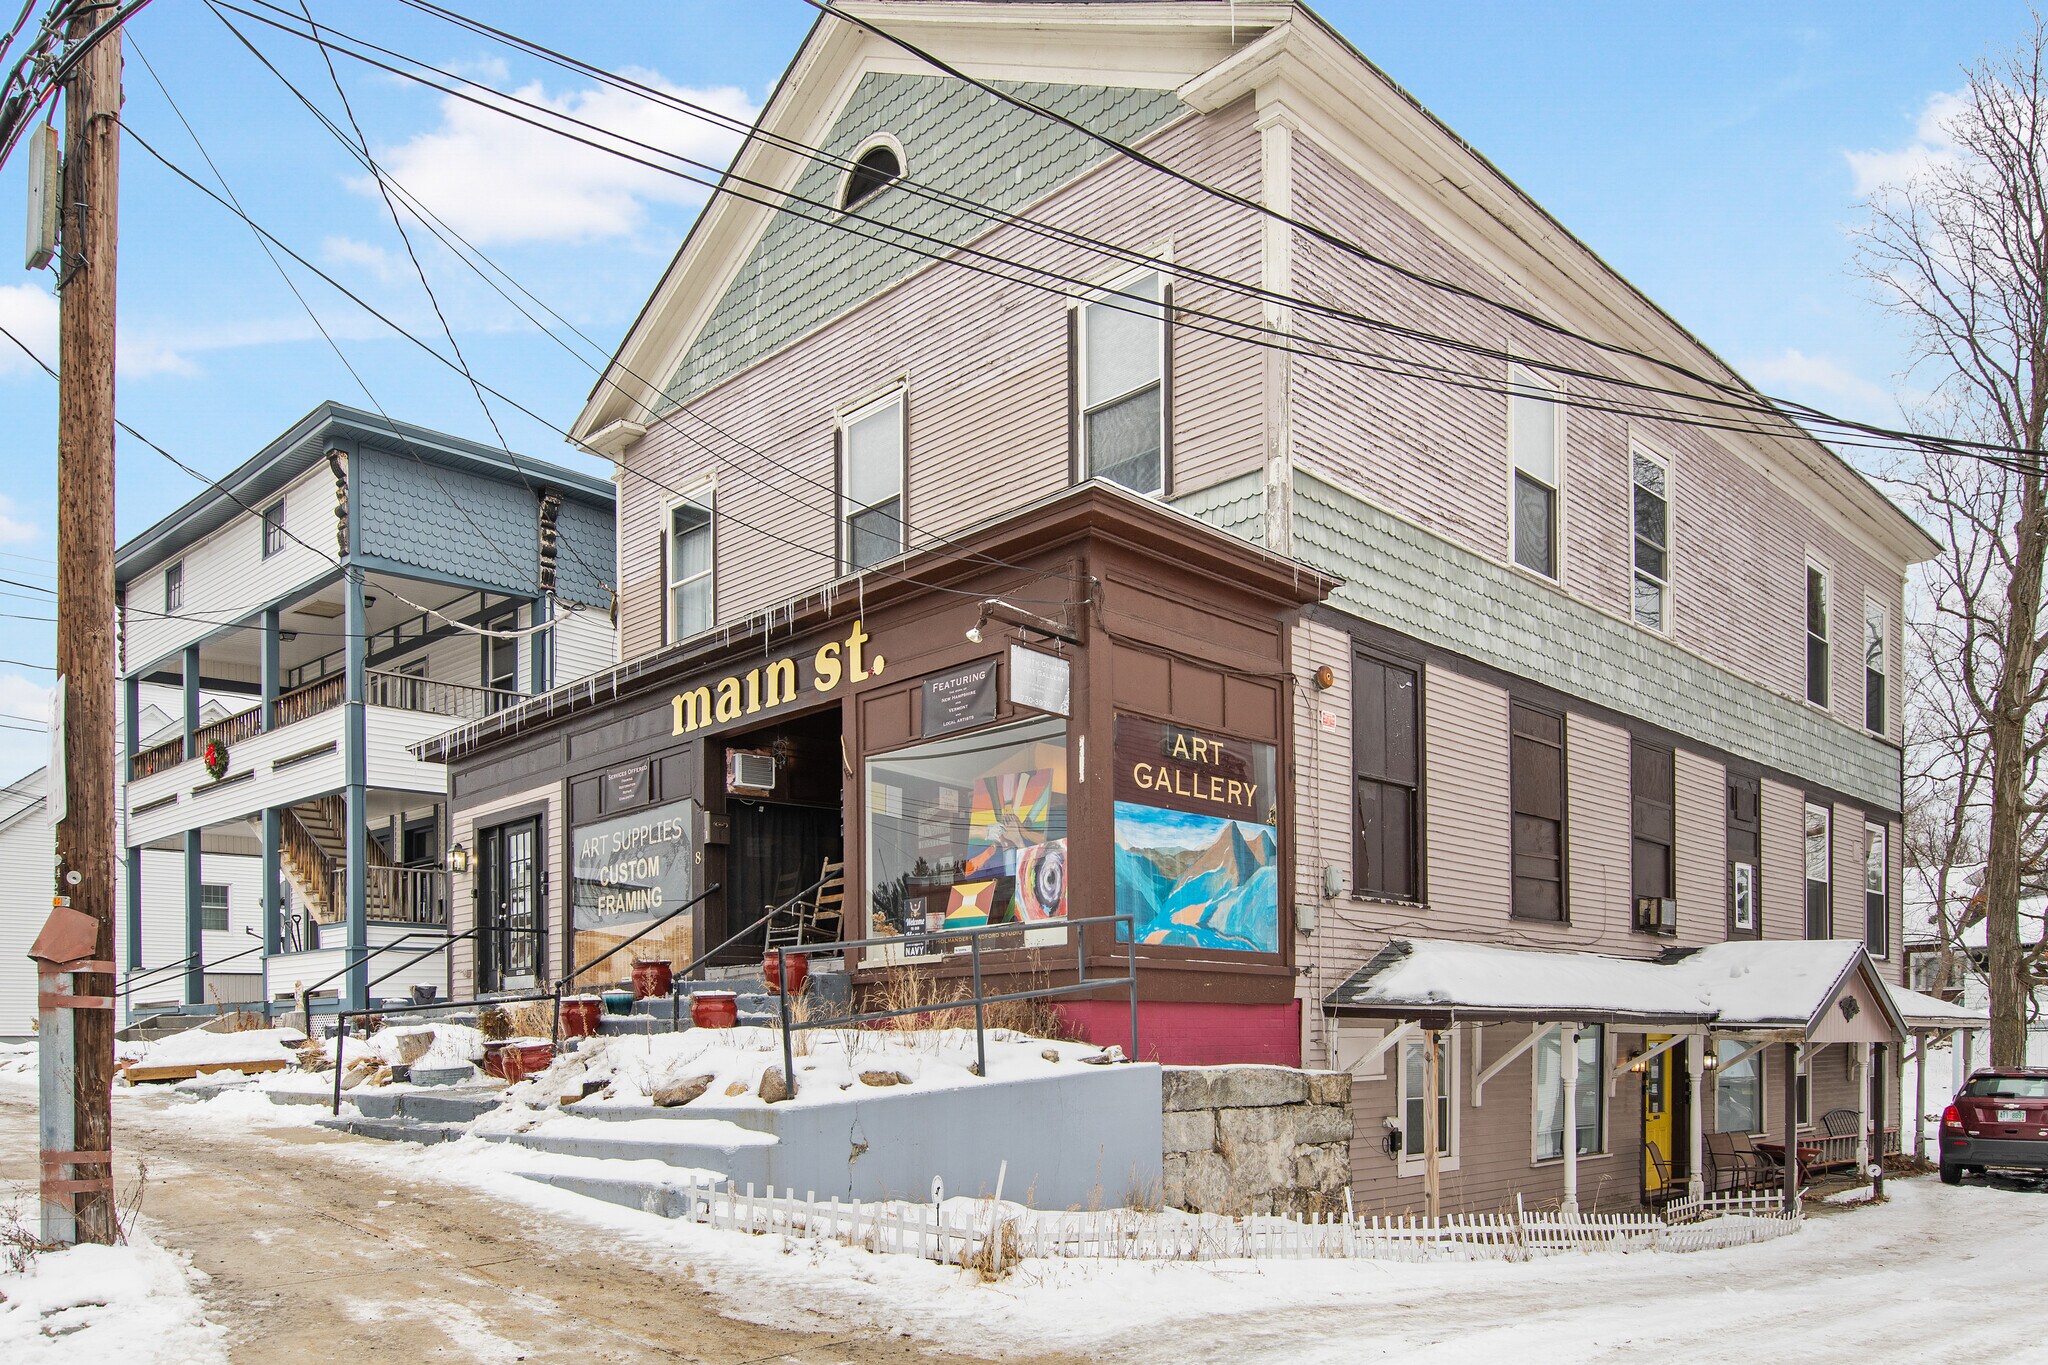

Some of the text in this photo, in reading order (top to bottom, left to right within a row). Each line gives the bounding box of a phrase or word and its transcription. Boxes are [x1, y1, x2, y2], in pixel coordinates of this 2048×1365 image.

[671, 620, 885, 737] main st.
[932, 670, 986, 693] FEATURING
[948, 704, 969, 713] VERMONT
[951, 690, 976, 700] HAMPSHIRE
[956, 715, 975, 724] ARTISTS
[1172, 733, 1224, 766] ART
[1133, 762, 1258, 807] GALLERY
[581, 817, 683, 860] ART SUPPLIES
[600, 855, 660, 887] CUSTOM
[695, 851, 701, 865] 8
[598, 886, 663, 917] FRAMING
[905, 945, 925, 957] NAVY
